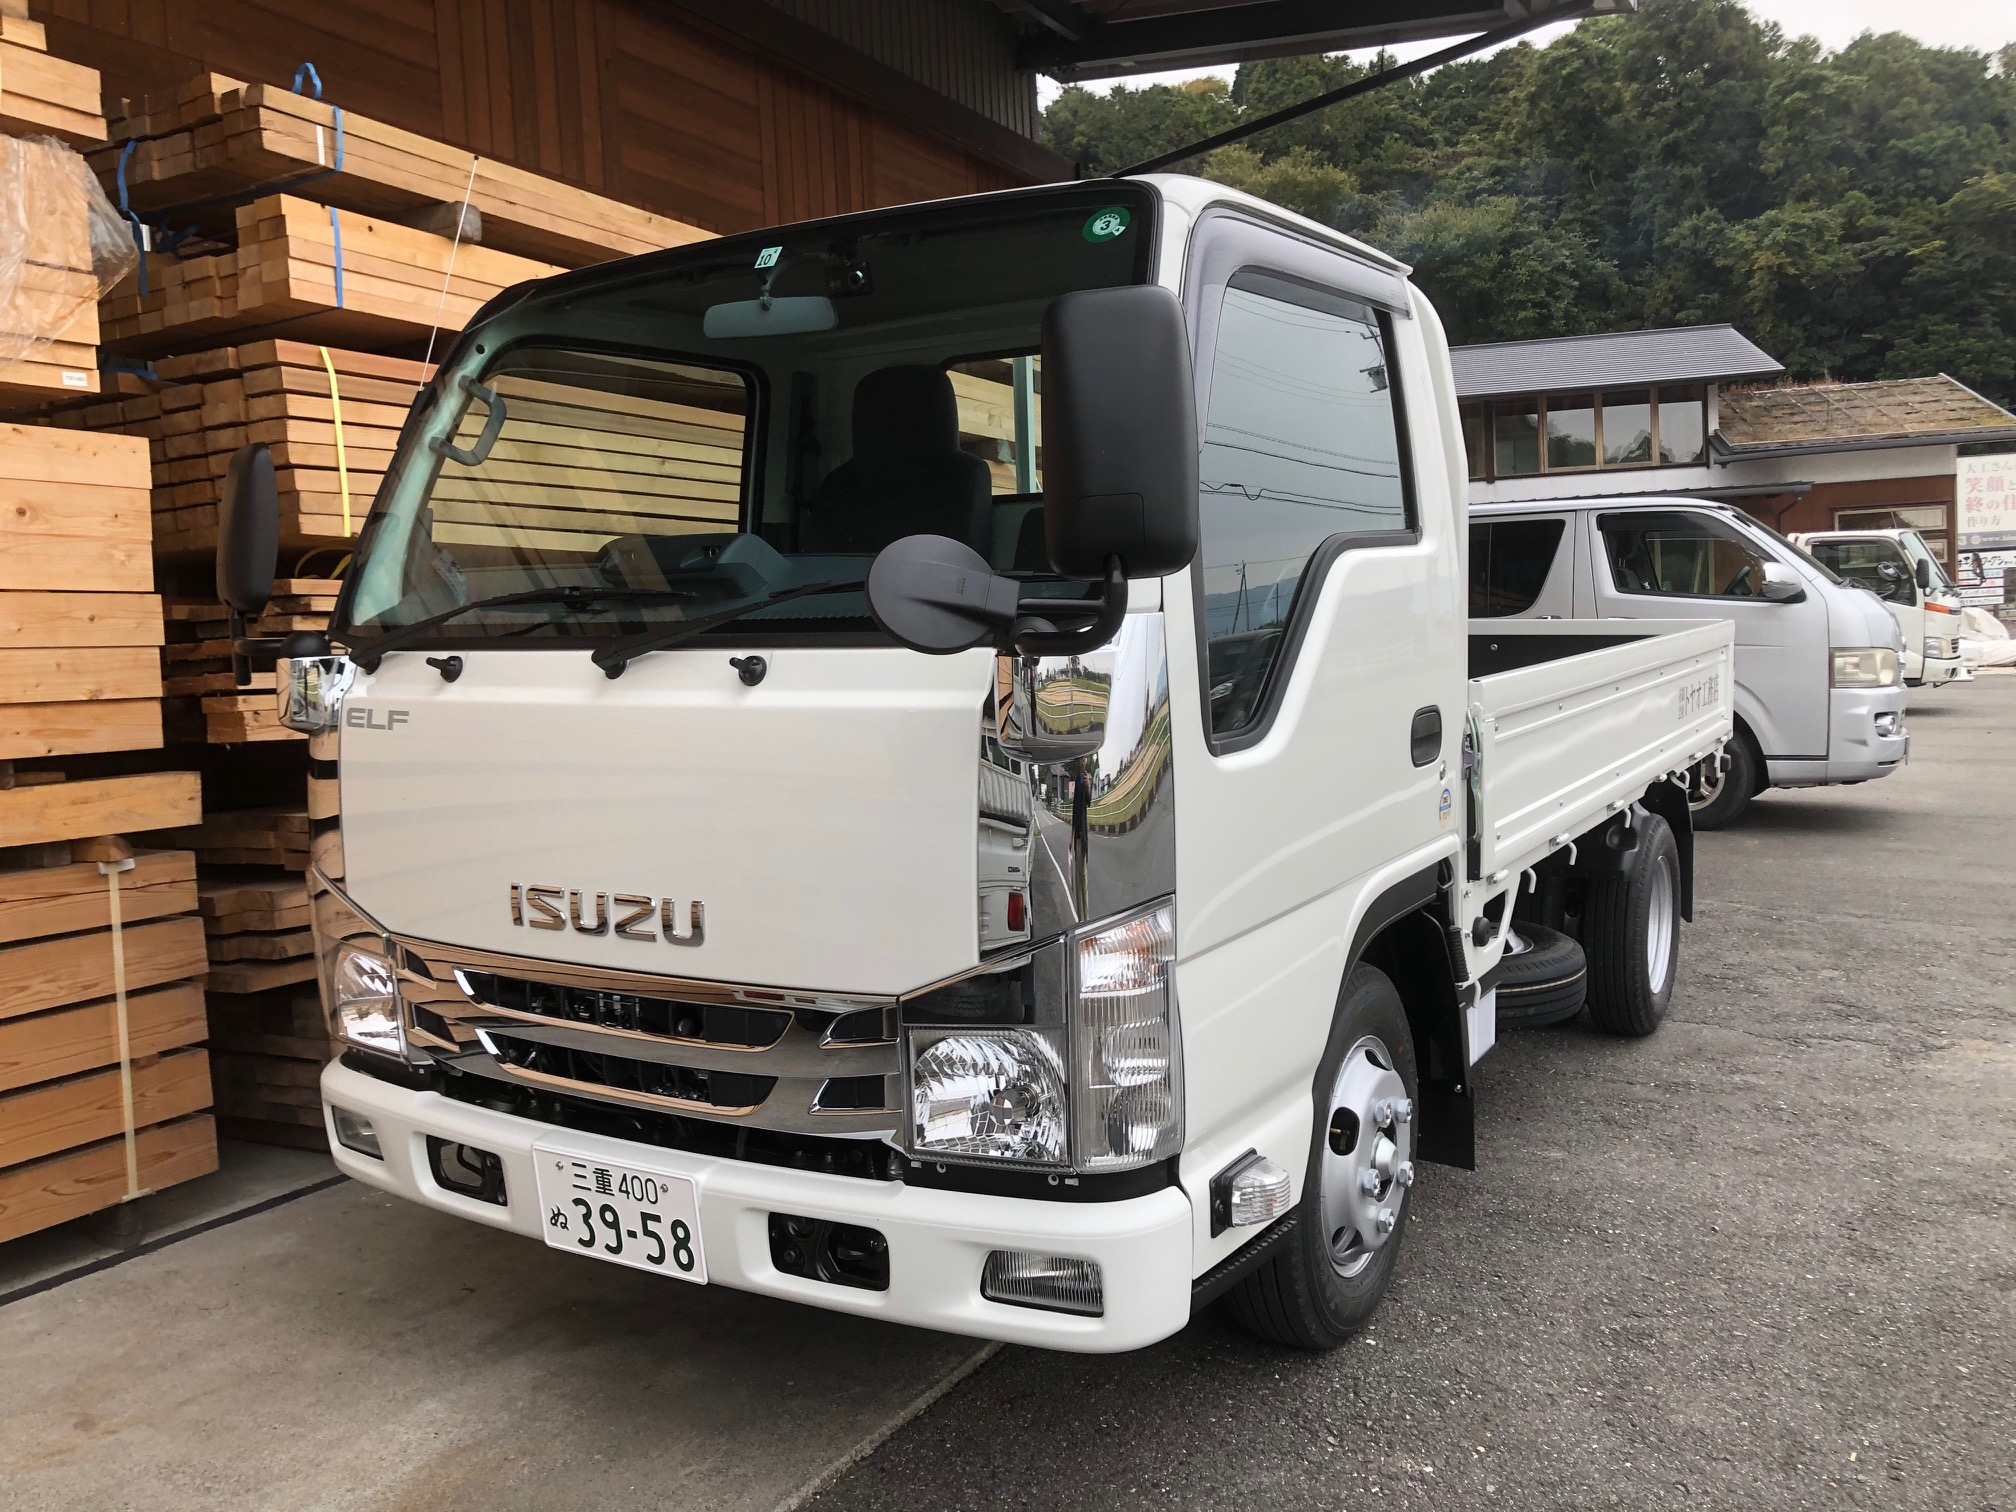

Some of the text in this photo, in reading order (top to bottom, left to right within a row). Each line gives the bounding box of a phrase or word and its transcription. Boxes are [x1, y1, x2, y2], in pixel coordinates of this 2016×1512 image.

[1100, 220, 1111, 231] 3
[757, 253, 772, 266] 10
[1966, 461, 2016, 474] 大工さん
[1965, 475, 2016, 494] 笑顔と
[1967, 515, 2001, 528] 作り方
[346, 707, 410, 731] ELF
[510, 881, 705, 947] ISUZU
[550, 1197, 695, 1272] ぬ 39-58
